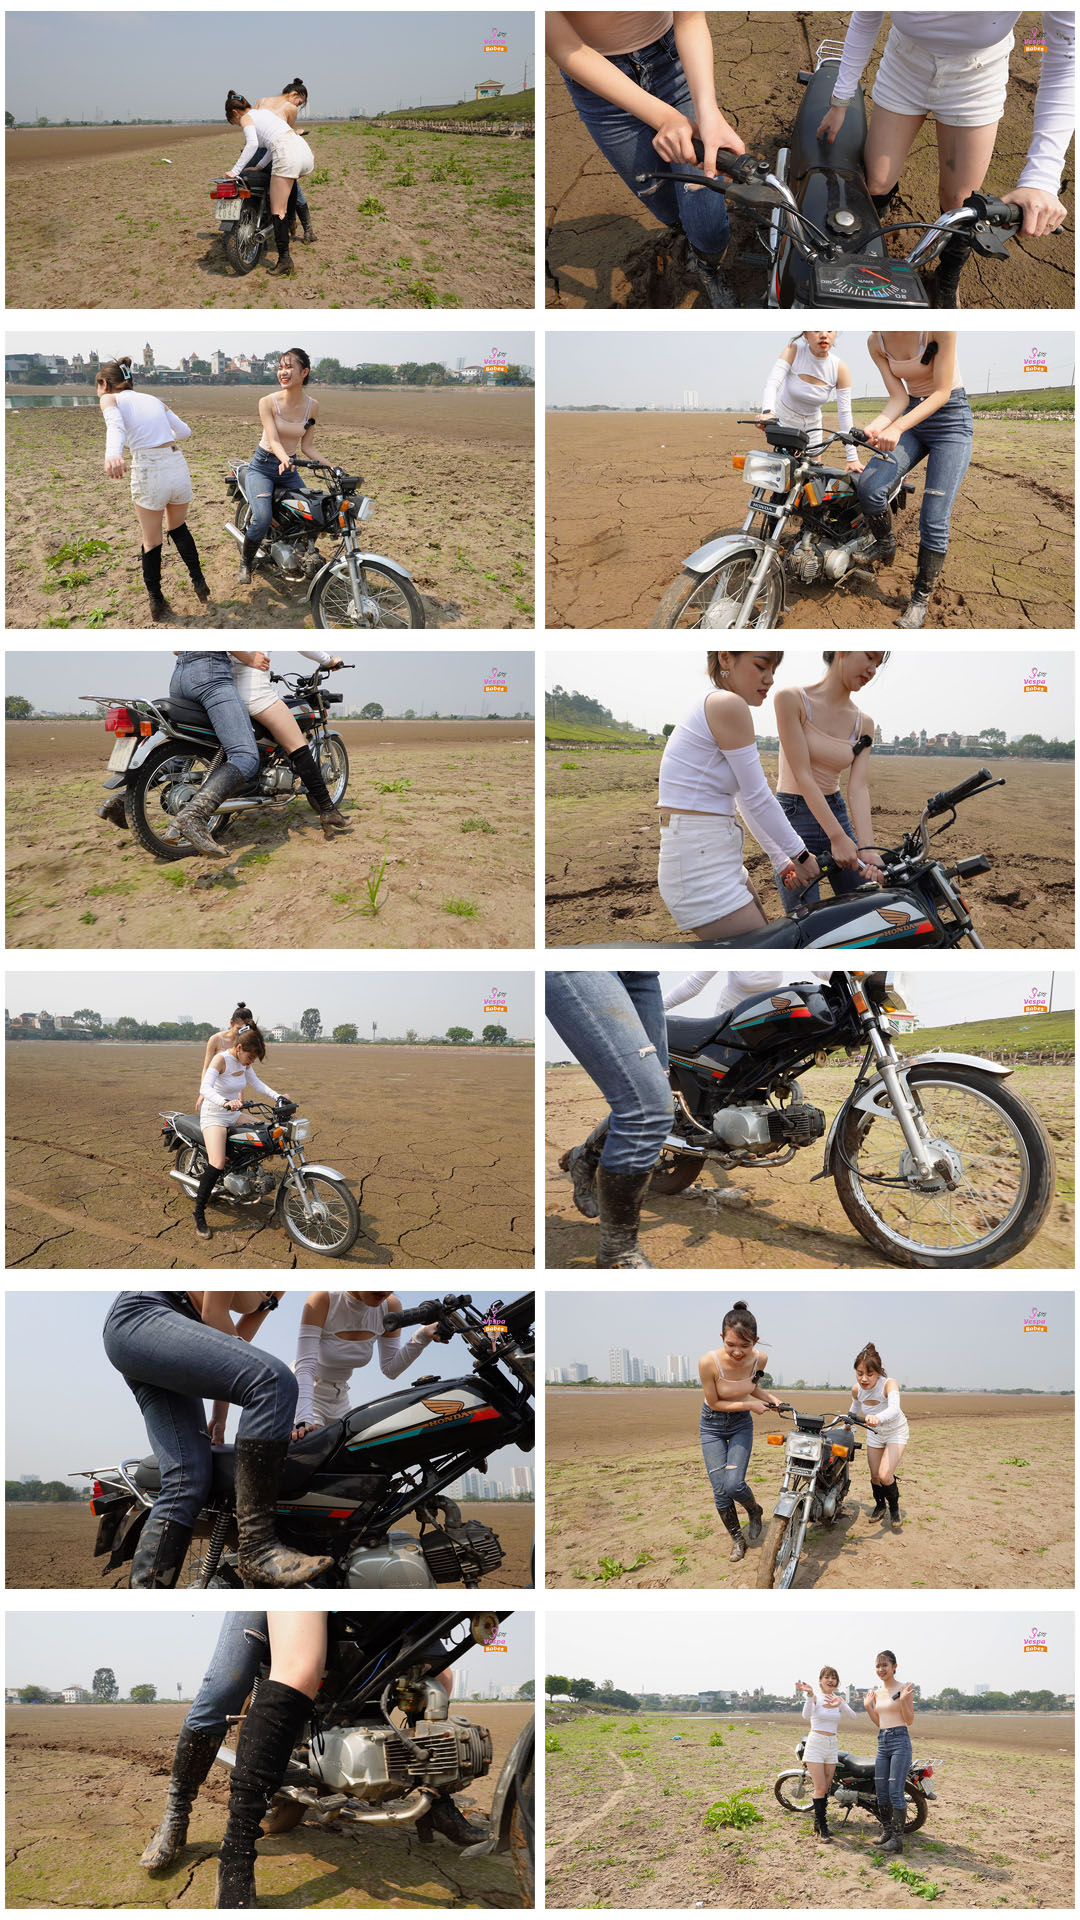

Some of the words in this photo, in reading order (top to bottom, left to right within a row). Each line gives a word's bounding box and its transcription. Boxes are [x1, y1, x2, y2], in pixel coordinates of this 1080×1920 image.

[752, 502, 773, 512] HONDA
[884, 922, 916, 936] HONDA
[767, 1008, 792, 1017] HONDA
[428, 1410, 473, 1427] HONDA
